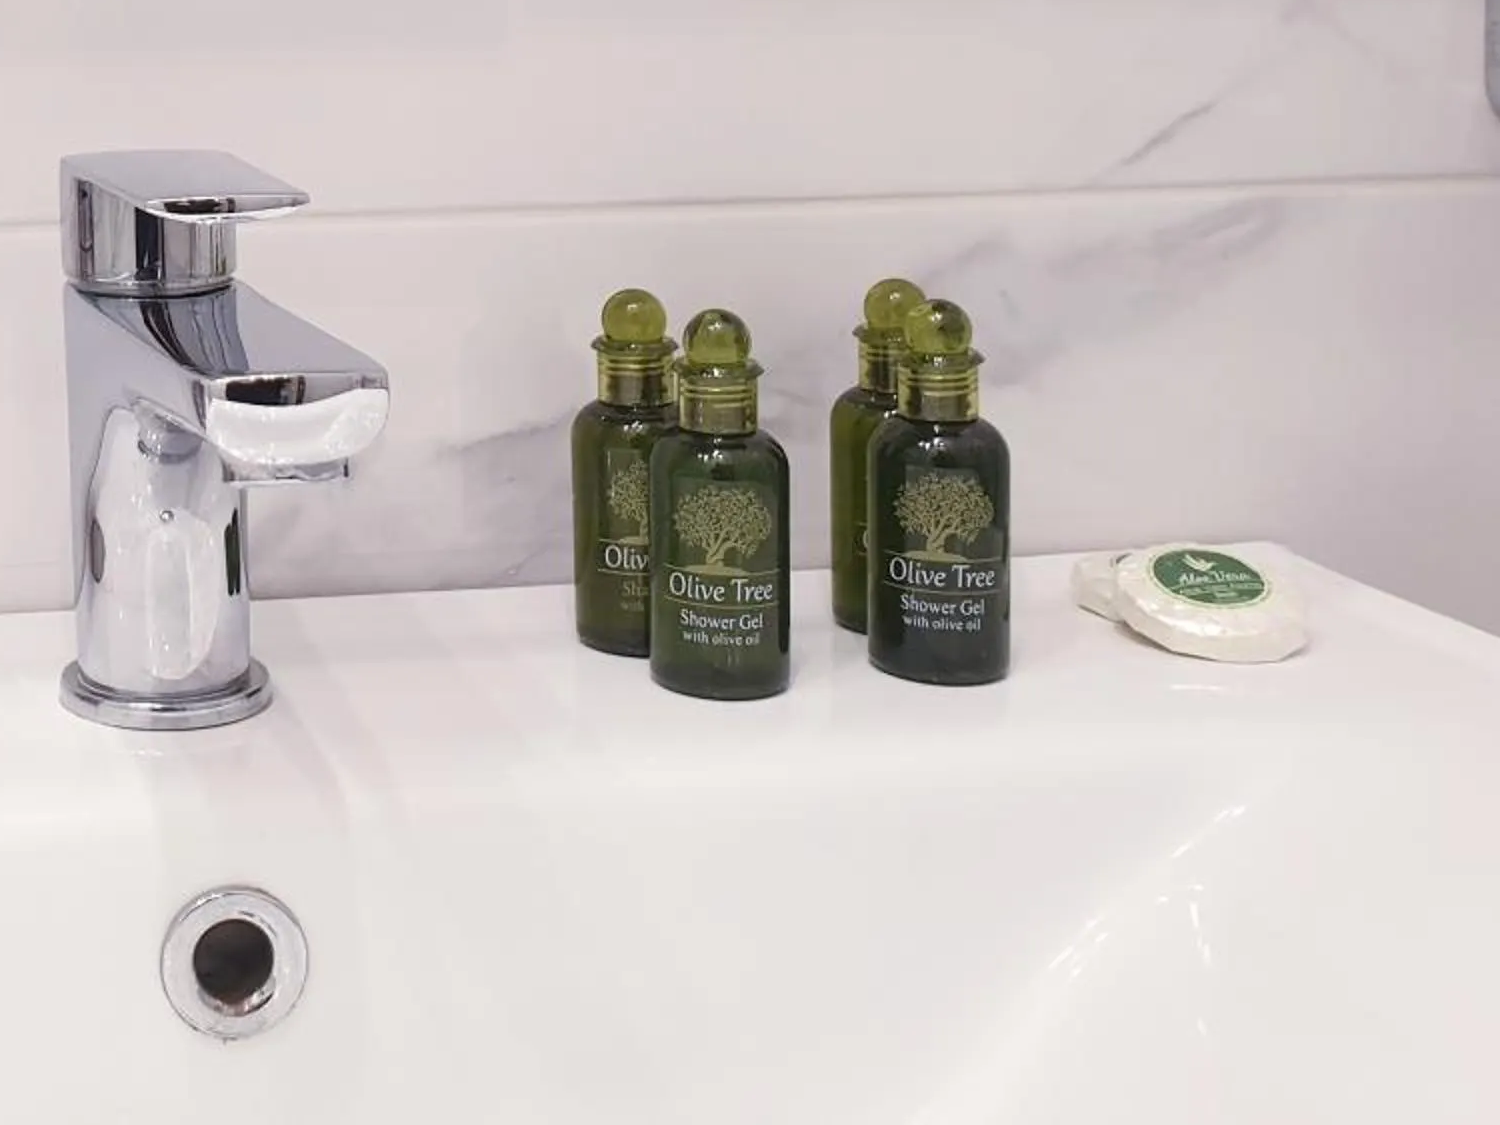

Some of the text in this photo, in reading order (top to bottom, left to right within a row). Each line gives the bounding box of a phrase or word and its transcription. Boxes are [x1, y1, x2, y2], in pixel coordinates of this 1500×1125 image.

[604, 544, 649, 570] Oliv
[889, 557, 996, 588] Olive Tree
[668, 571, 725, 602] Olive
[730, 578, 774, 603] Tree
[900, 594, 986, 616] Shower Gel
[679, 608, 764, 630] Shower Gel
[902, 614, 982, 633] with olive oil
[682, 630, 761, 646] with olive oil
